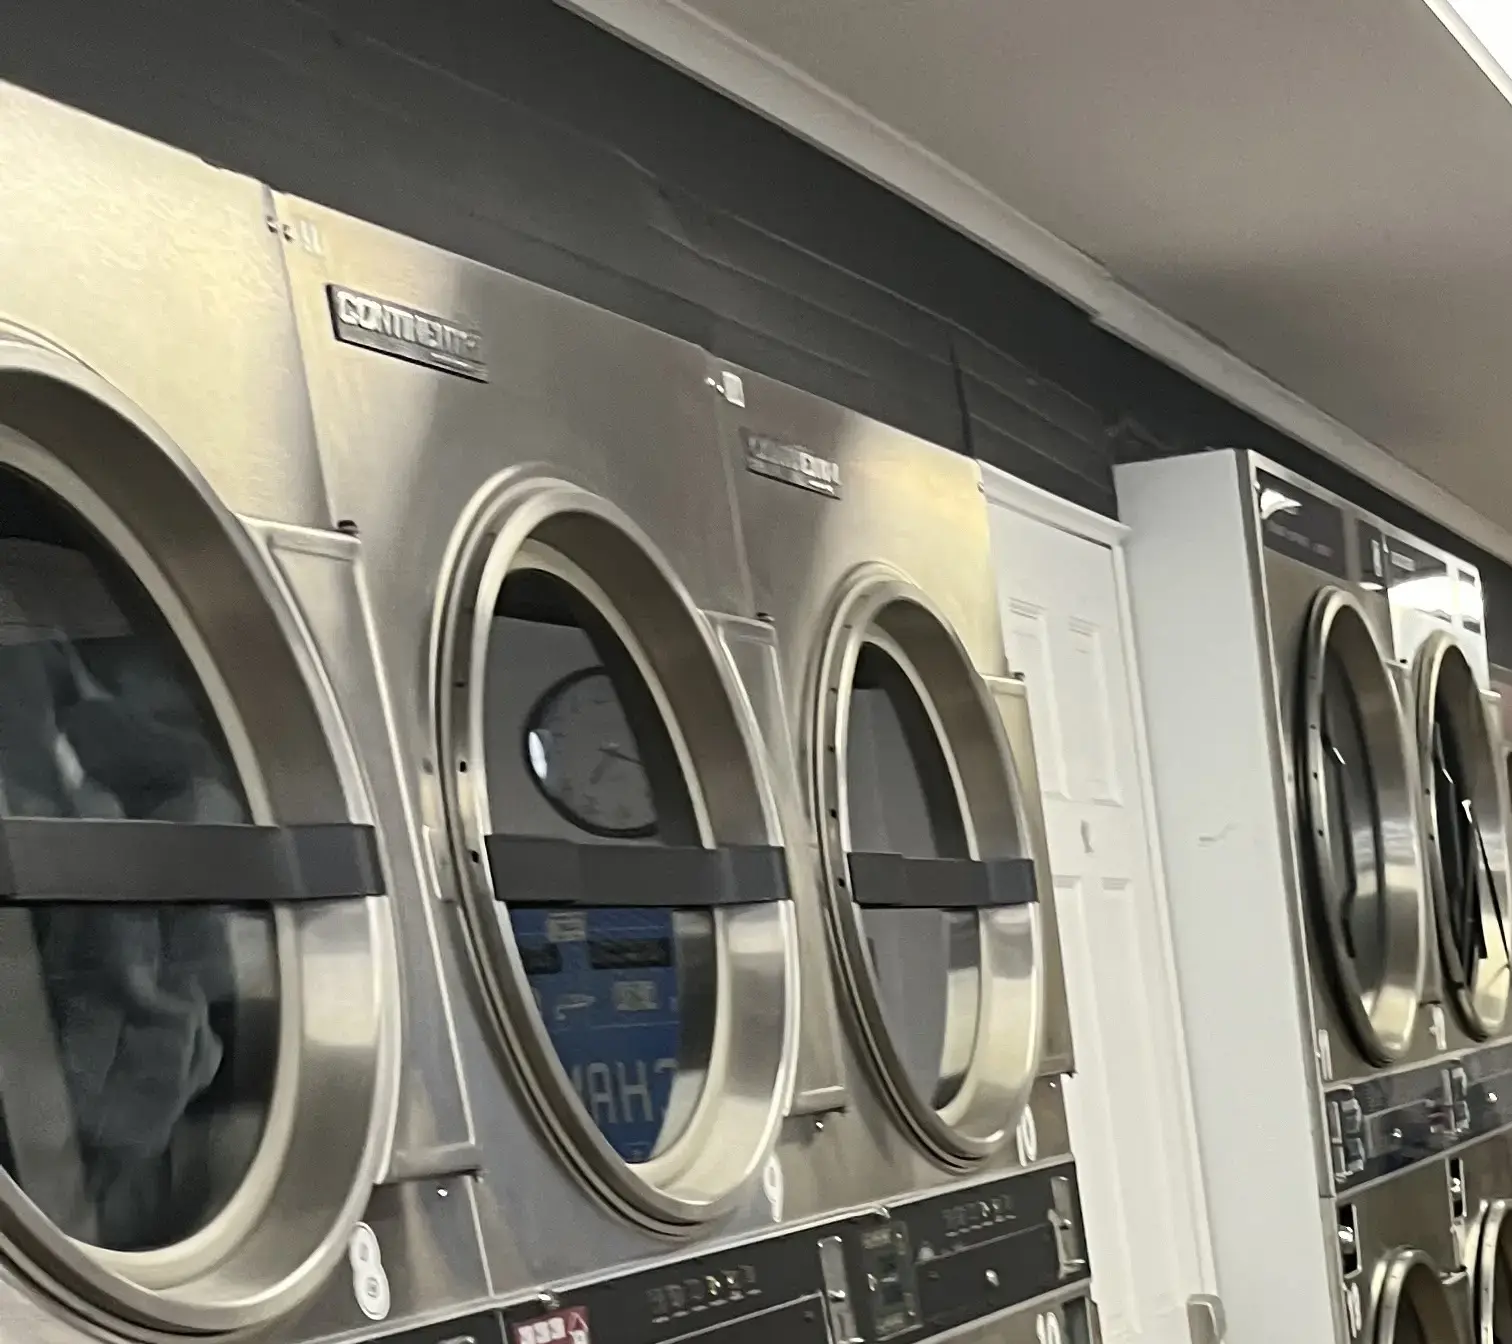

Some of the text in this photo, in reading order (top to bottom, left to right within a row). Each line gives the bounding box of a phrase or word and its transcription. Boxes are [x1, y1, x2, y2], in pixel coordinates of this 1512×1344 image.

[1016, 1103, 1038, 1168] 10
[763, 1153, 783, 1223] 9
[350, 1220, 391, 1321] 8
